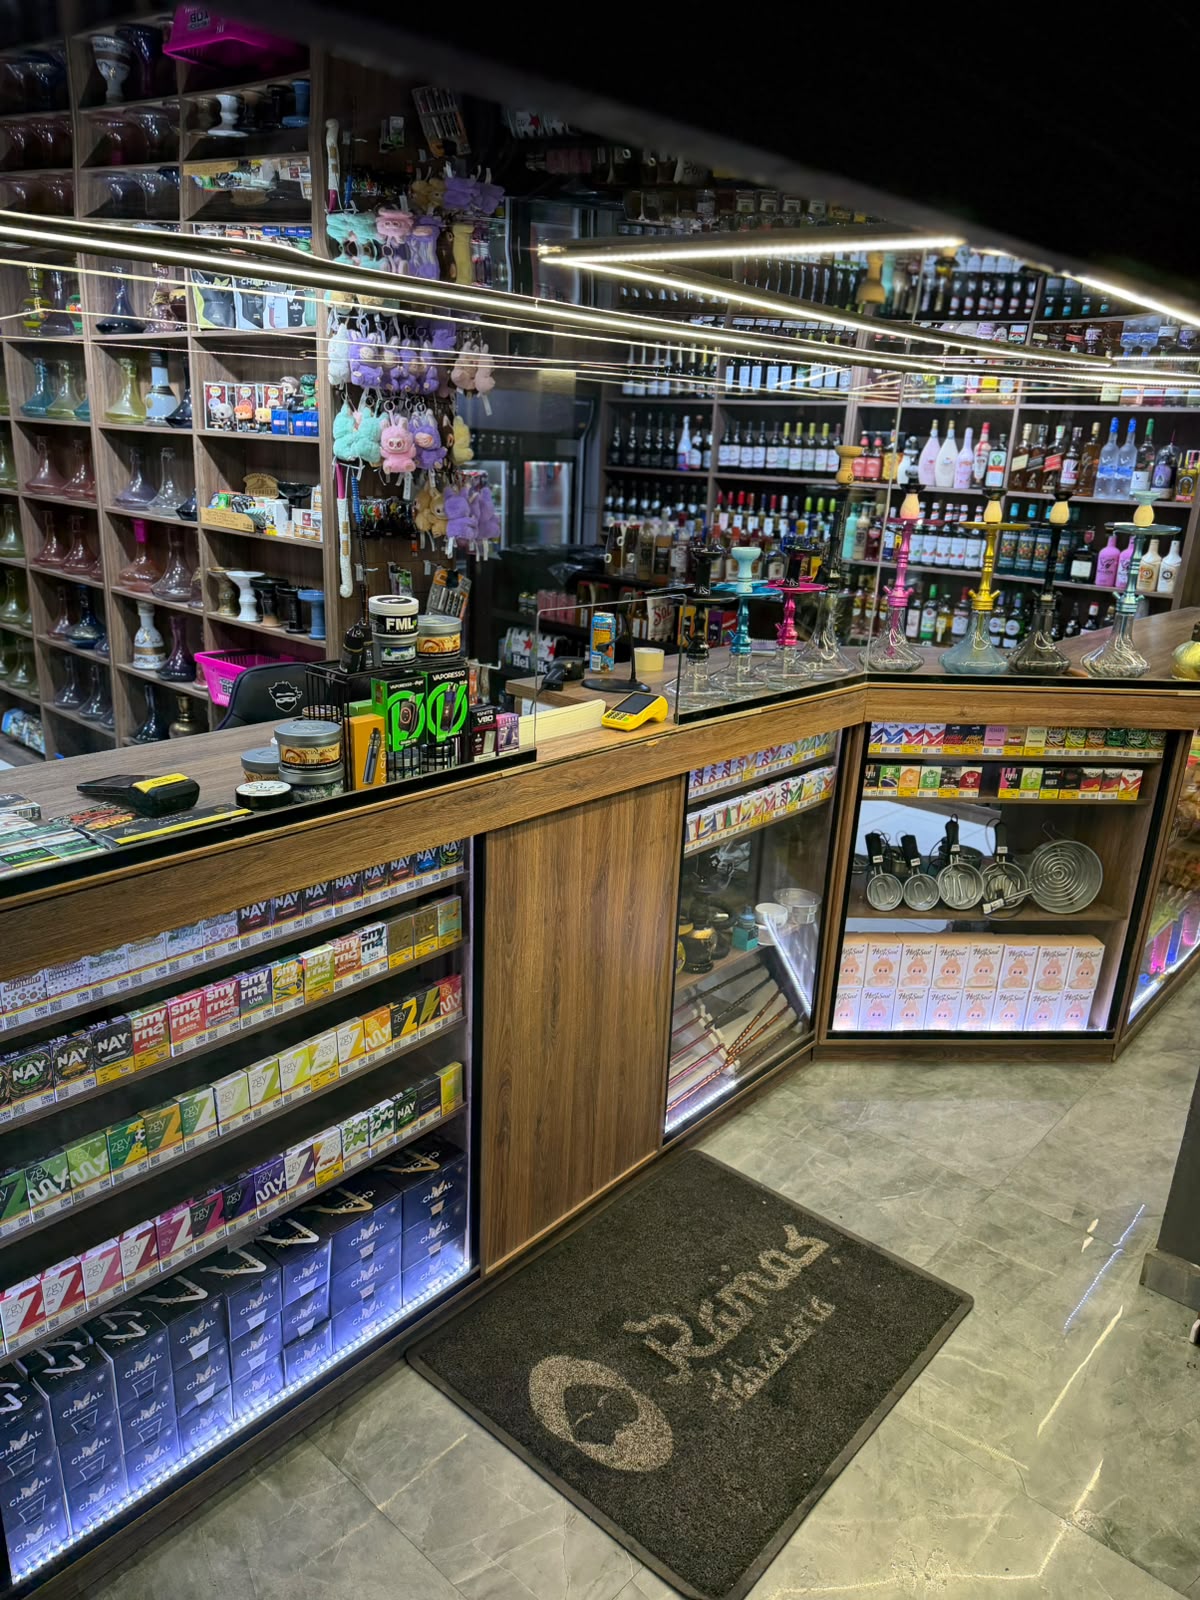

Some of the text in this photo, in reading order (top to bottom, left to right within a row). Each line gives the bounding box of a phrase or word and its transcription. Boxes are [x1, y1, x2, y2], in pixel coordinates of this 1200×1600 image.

[416, 847, 437, 862] NAY
[444, 840, 461, 853] NAY
[390, 856, 411, 870] NAY
[364, 864, 386, 880] NAY
[335, 873, 359, 889] NAY
[305, 882, 329, 899] NAY
[274, 892, 300, 908] NAY
[241, 901, 267, 920] NAY
[97, 1032, 128, 1054] NAY
[57, 1047, 90, 1069] NAY
[12, 1060, 47, 1082] NAY
[397, 1101, 416, 1119] NAY
